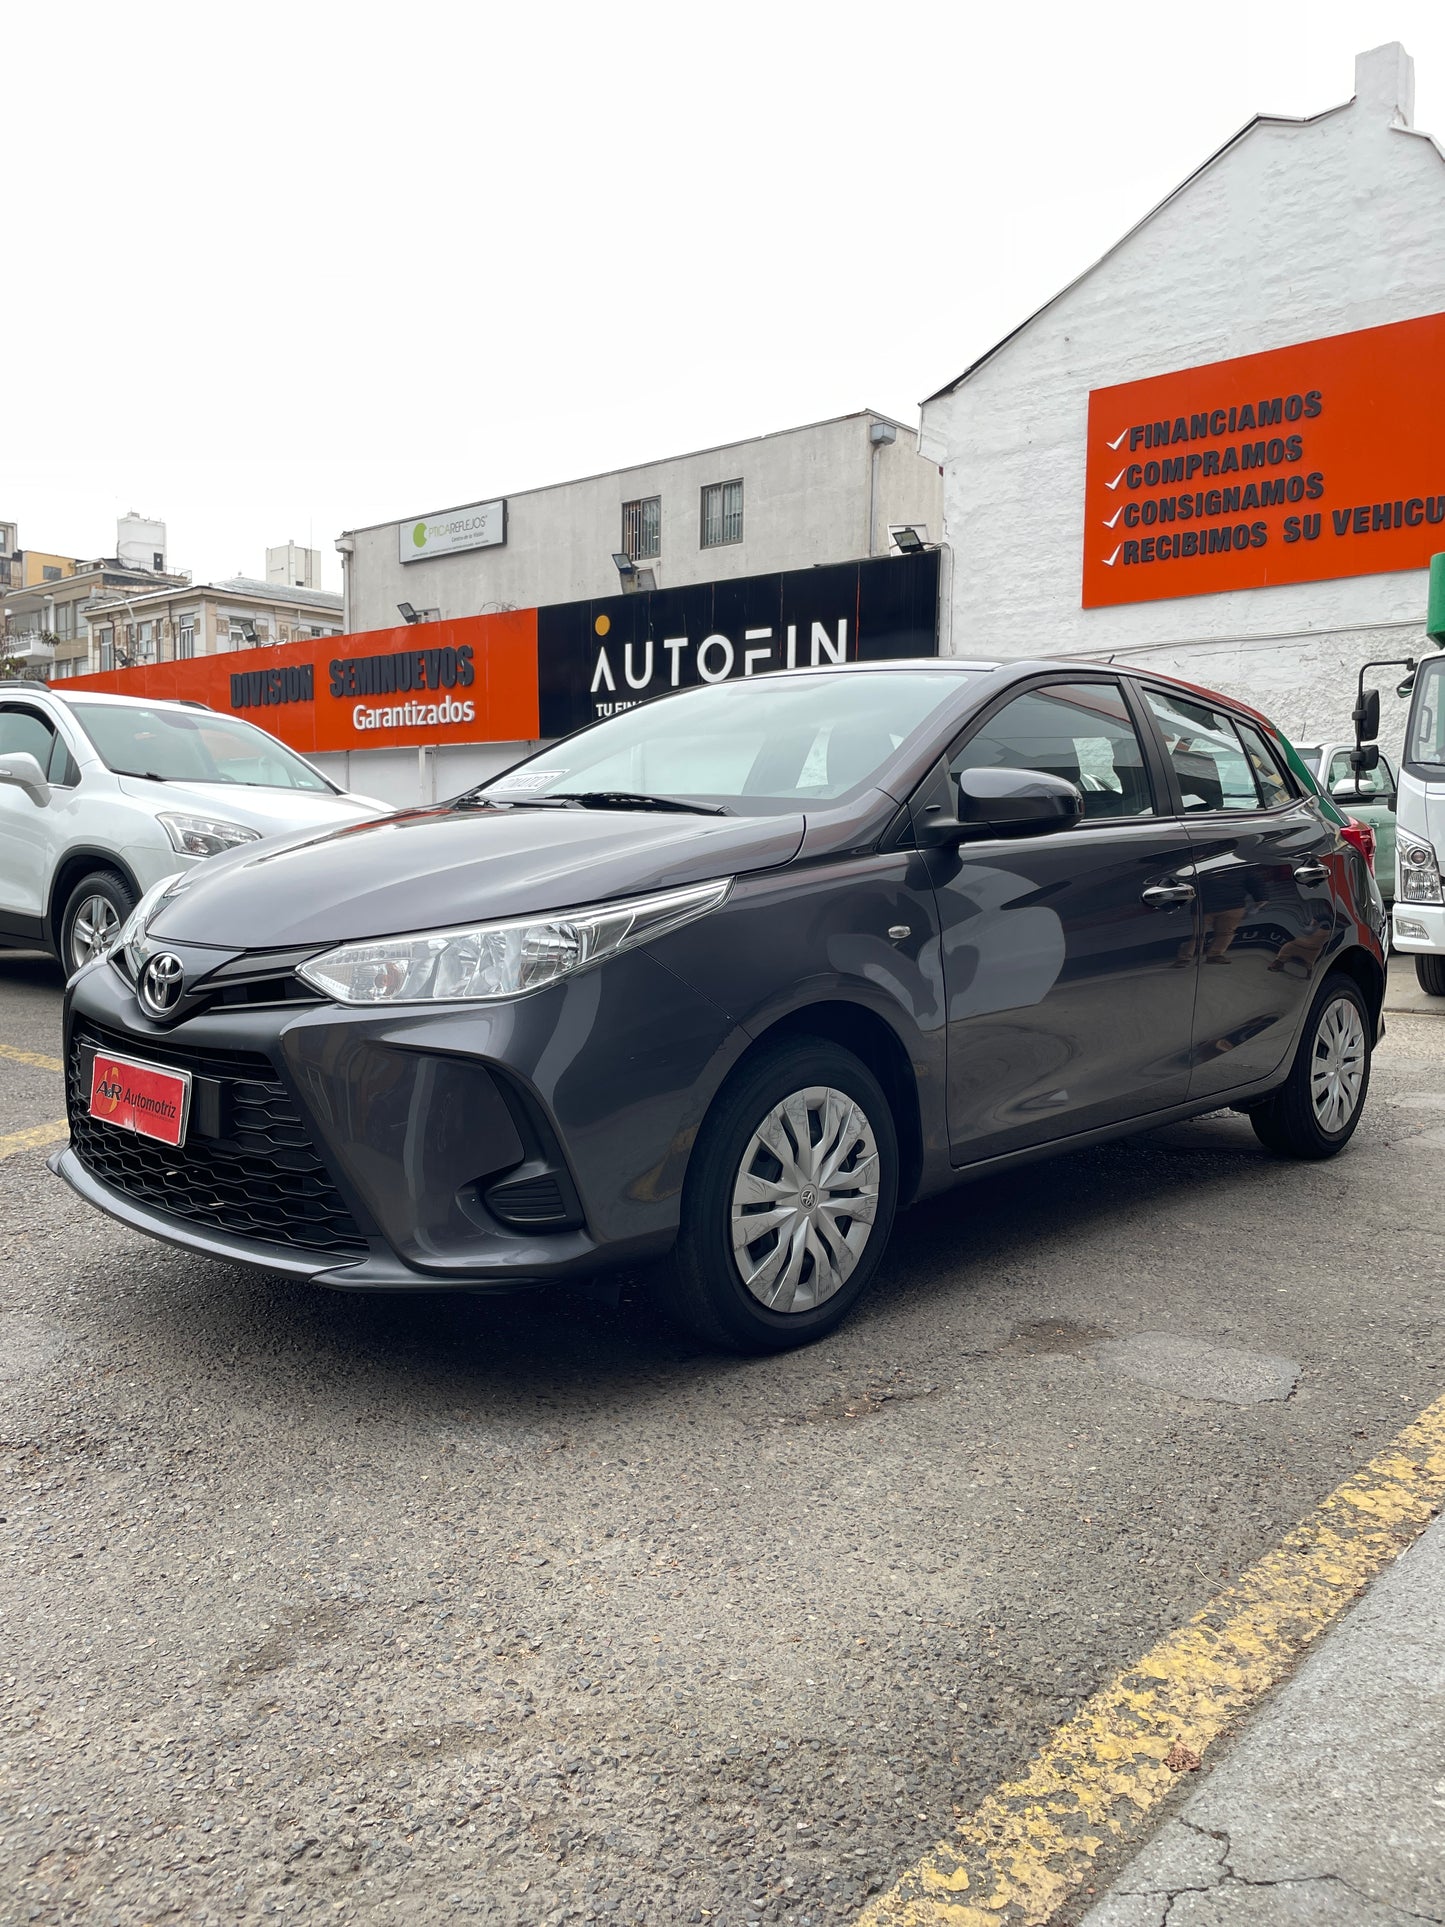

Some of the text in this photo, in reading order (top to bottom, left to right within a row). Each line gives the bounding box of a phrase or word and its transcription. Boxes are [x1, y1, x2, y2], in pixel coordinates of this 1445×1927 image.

[1129, 390, 1322, 452] FINANCIAMOS
[1126, 435, 1303, 489] COMPRAMOS
[1123, 472, 1324, 528] CONSIGNAMOS
[1123, 495, 1445, 565] RECIBIMOS SU VEHICU
[230, 645, 475, 708] DIVISION SEMINUEVOS
[590, 617, 848, 692] AUTOFIN
[352, 695, 475, 730] Garantizados
[595, 703, 613, 717] TU
[123, 1088, 177, 1119] Automotriz
